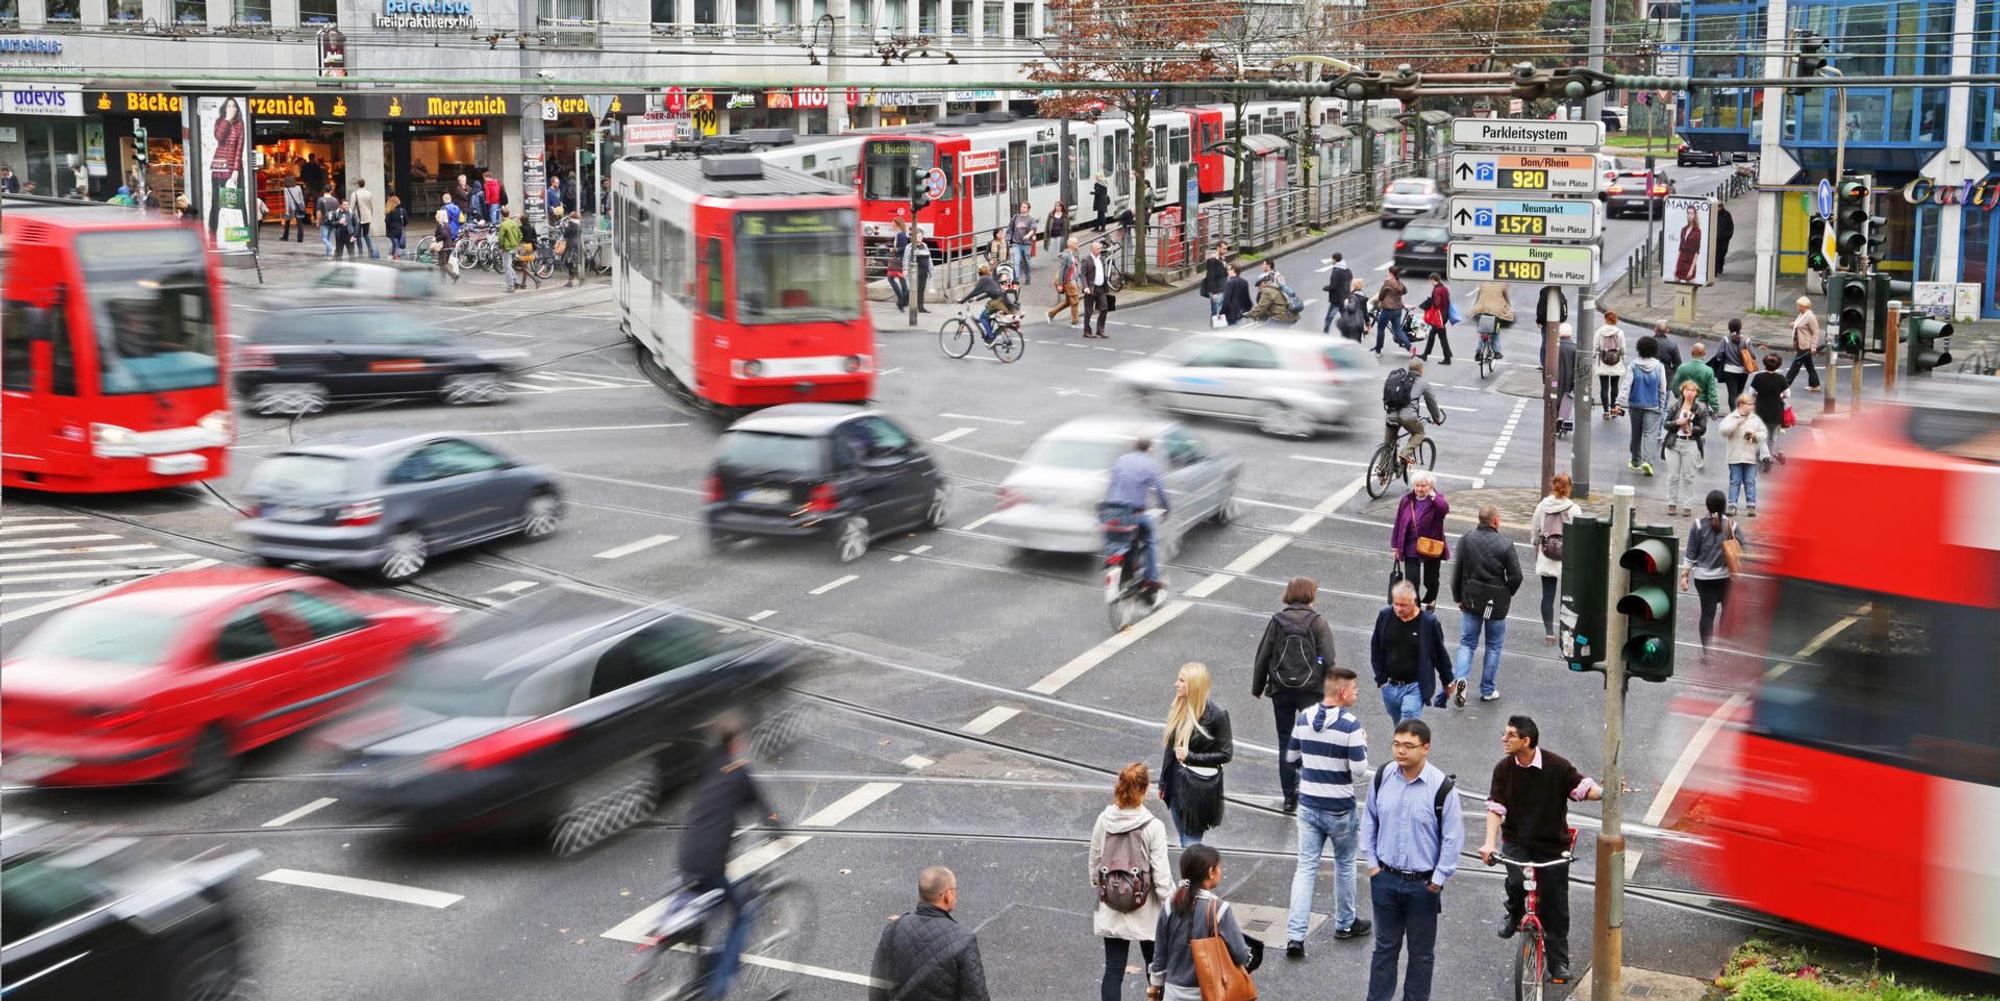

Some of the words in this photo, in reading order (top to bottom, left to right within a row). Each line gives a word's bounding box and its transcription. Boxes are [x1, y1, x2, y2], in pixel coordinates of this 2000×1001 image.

[375, 13, 482, 29] heilpraktikerschule
[249, 96, 316, 115] rzenich
[427, 96, 506, 116] Merzenich
[546, 107, 556, 118] 3
[1046, 128, 1055, 138] 4
[1483, 125, 1568, 142] Parkleitsystem
[1521, 157, 1569, 169] Dom/Rhein
[1512, 170, 1545, 189] 920
[1522, 203, 1564, 215] Neumarkt
[1665, 200, 1710, 212] MANGO
[1500, 216, 1543, 234] 1578
[1529, 249, 1553, 261] Ringe
[1498, 262, 1542, 280] 1480
